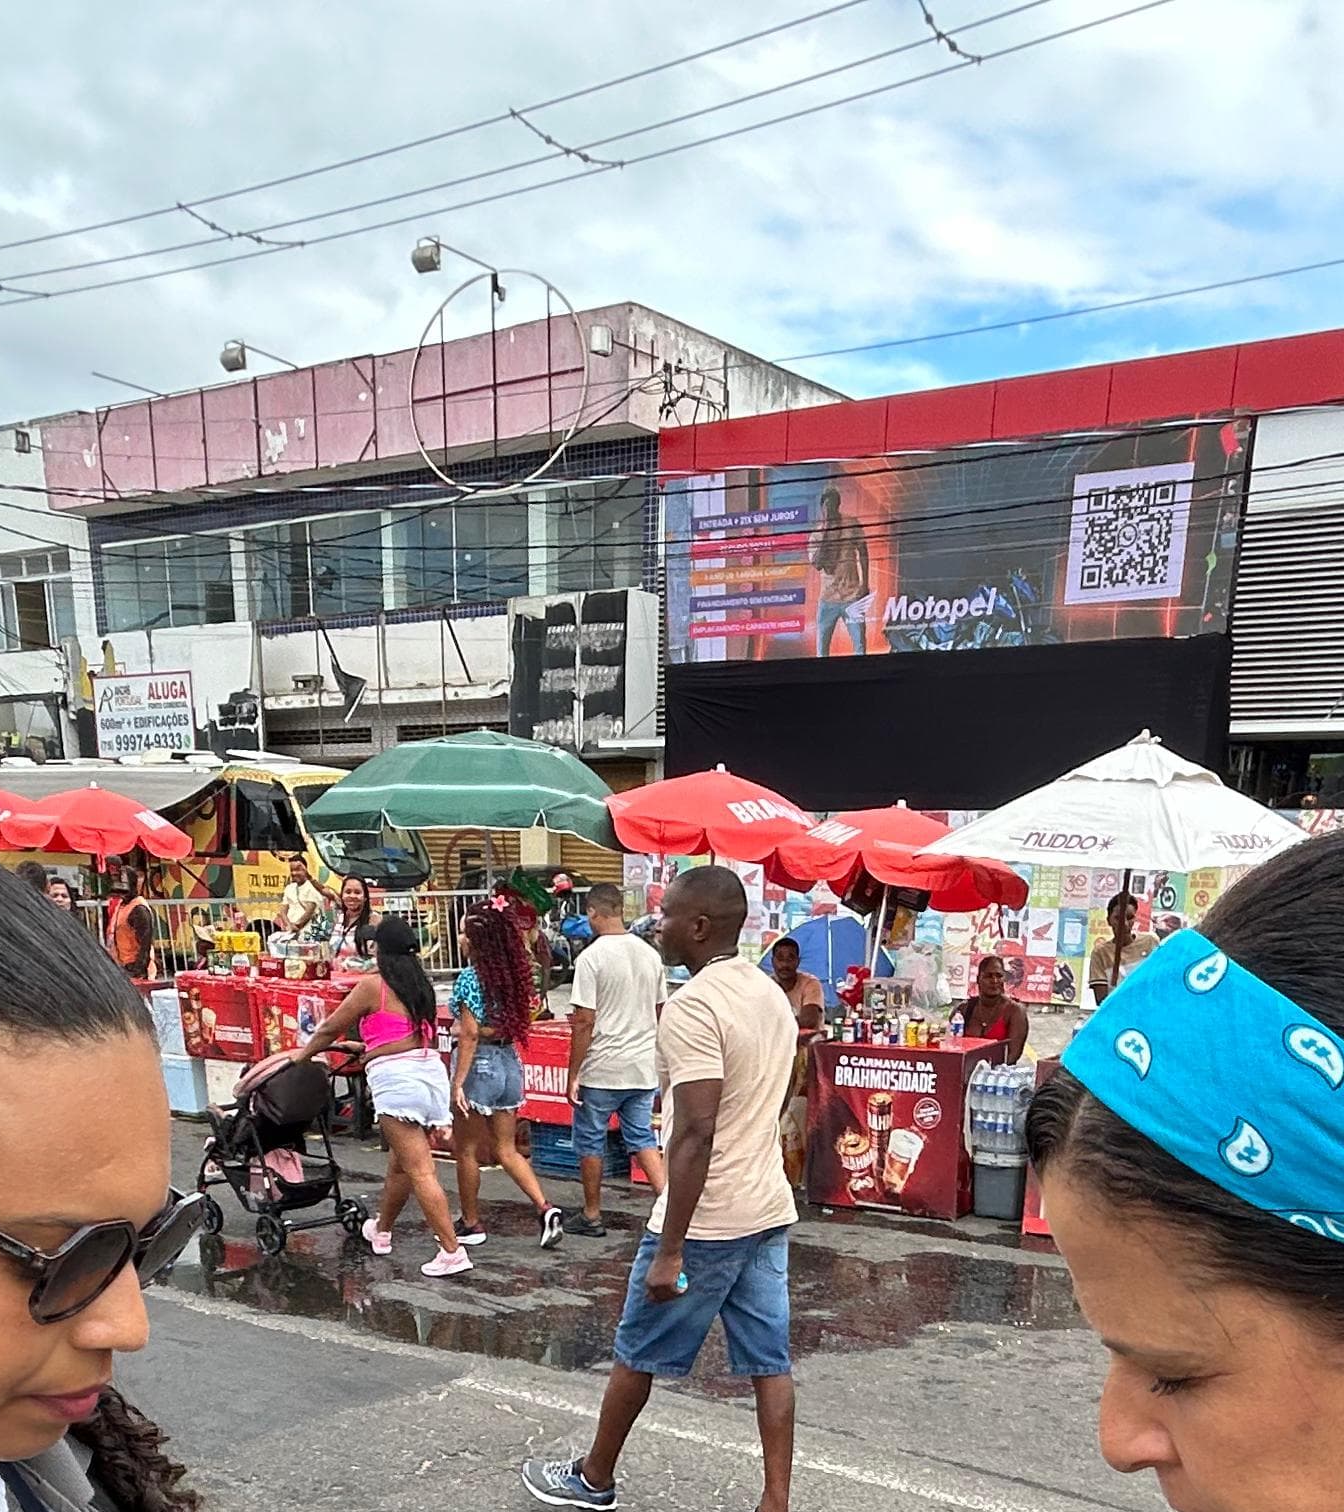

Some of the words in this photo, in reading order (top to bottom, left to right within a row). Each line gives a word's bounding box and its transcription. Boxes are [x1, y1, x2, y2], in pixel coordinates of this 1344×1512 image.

[883, 587, 997, 625] Motopel
[148, 680, 187, 701] ALUGA
[115, 731, 183, 752] 99974-9333
[839, 1055, 849, 1066] O
[850, 1056, 914, 1072] CARNAVAL
[916, 1061, 934, 1073] DA
[524, 1063, 570, 1095] BRAH
[835, 1066, 938, 1094] BRAHMOSIDADE
